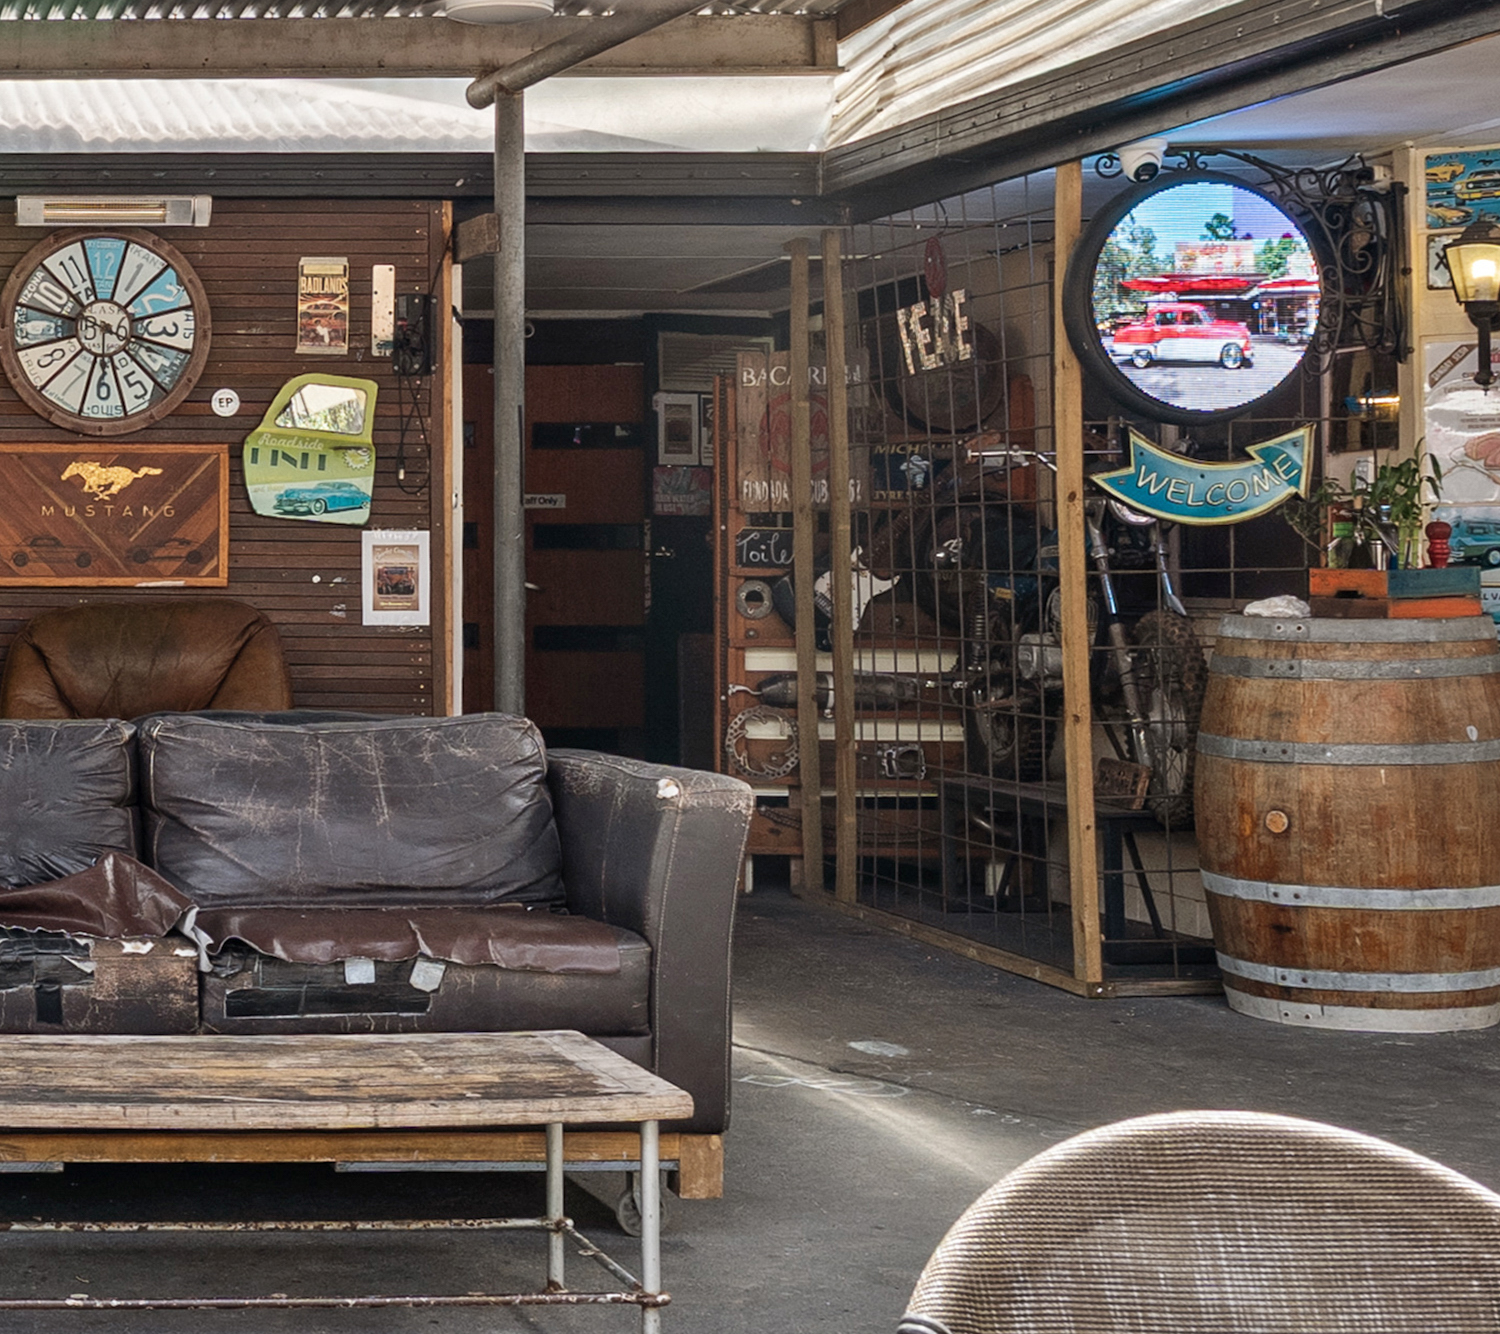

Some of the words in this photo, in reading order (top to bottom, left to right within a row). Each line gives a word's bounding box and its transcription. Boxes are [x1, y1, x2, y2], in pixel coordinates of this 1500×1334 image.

[300, 276, 349, 294] BADLANDS
[217, 397, 234, 409] EP
[257, 431, 326, 452] Roadside
[1134, 452, 1301, 509] WELCOME
[41, 503, 178, 519] MUSTANG
